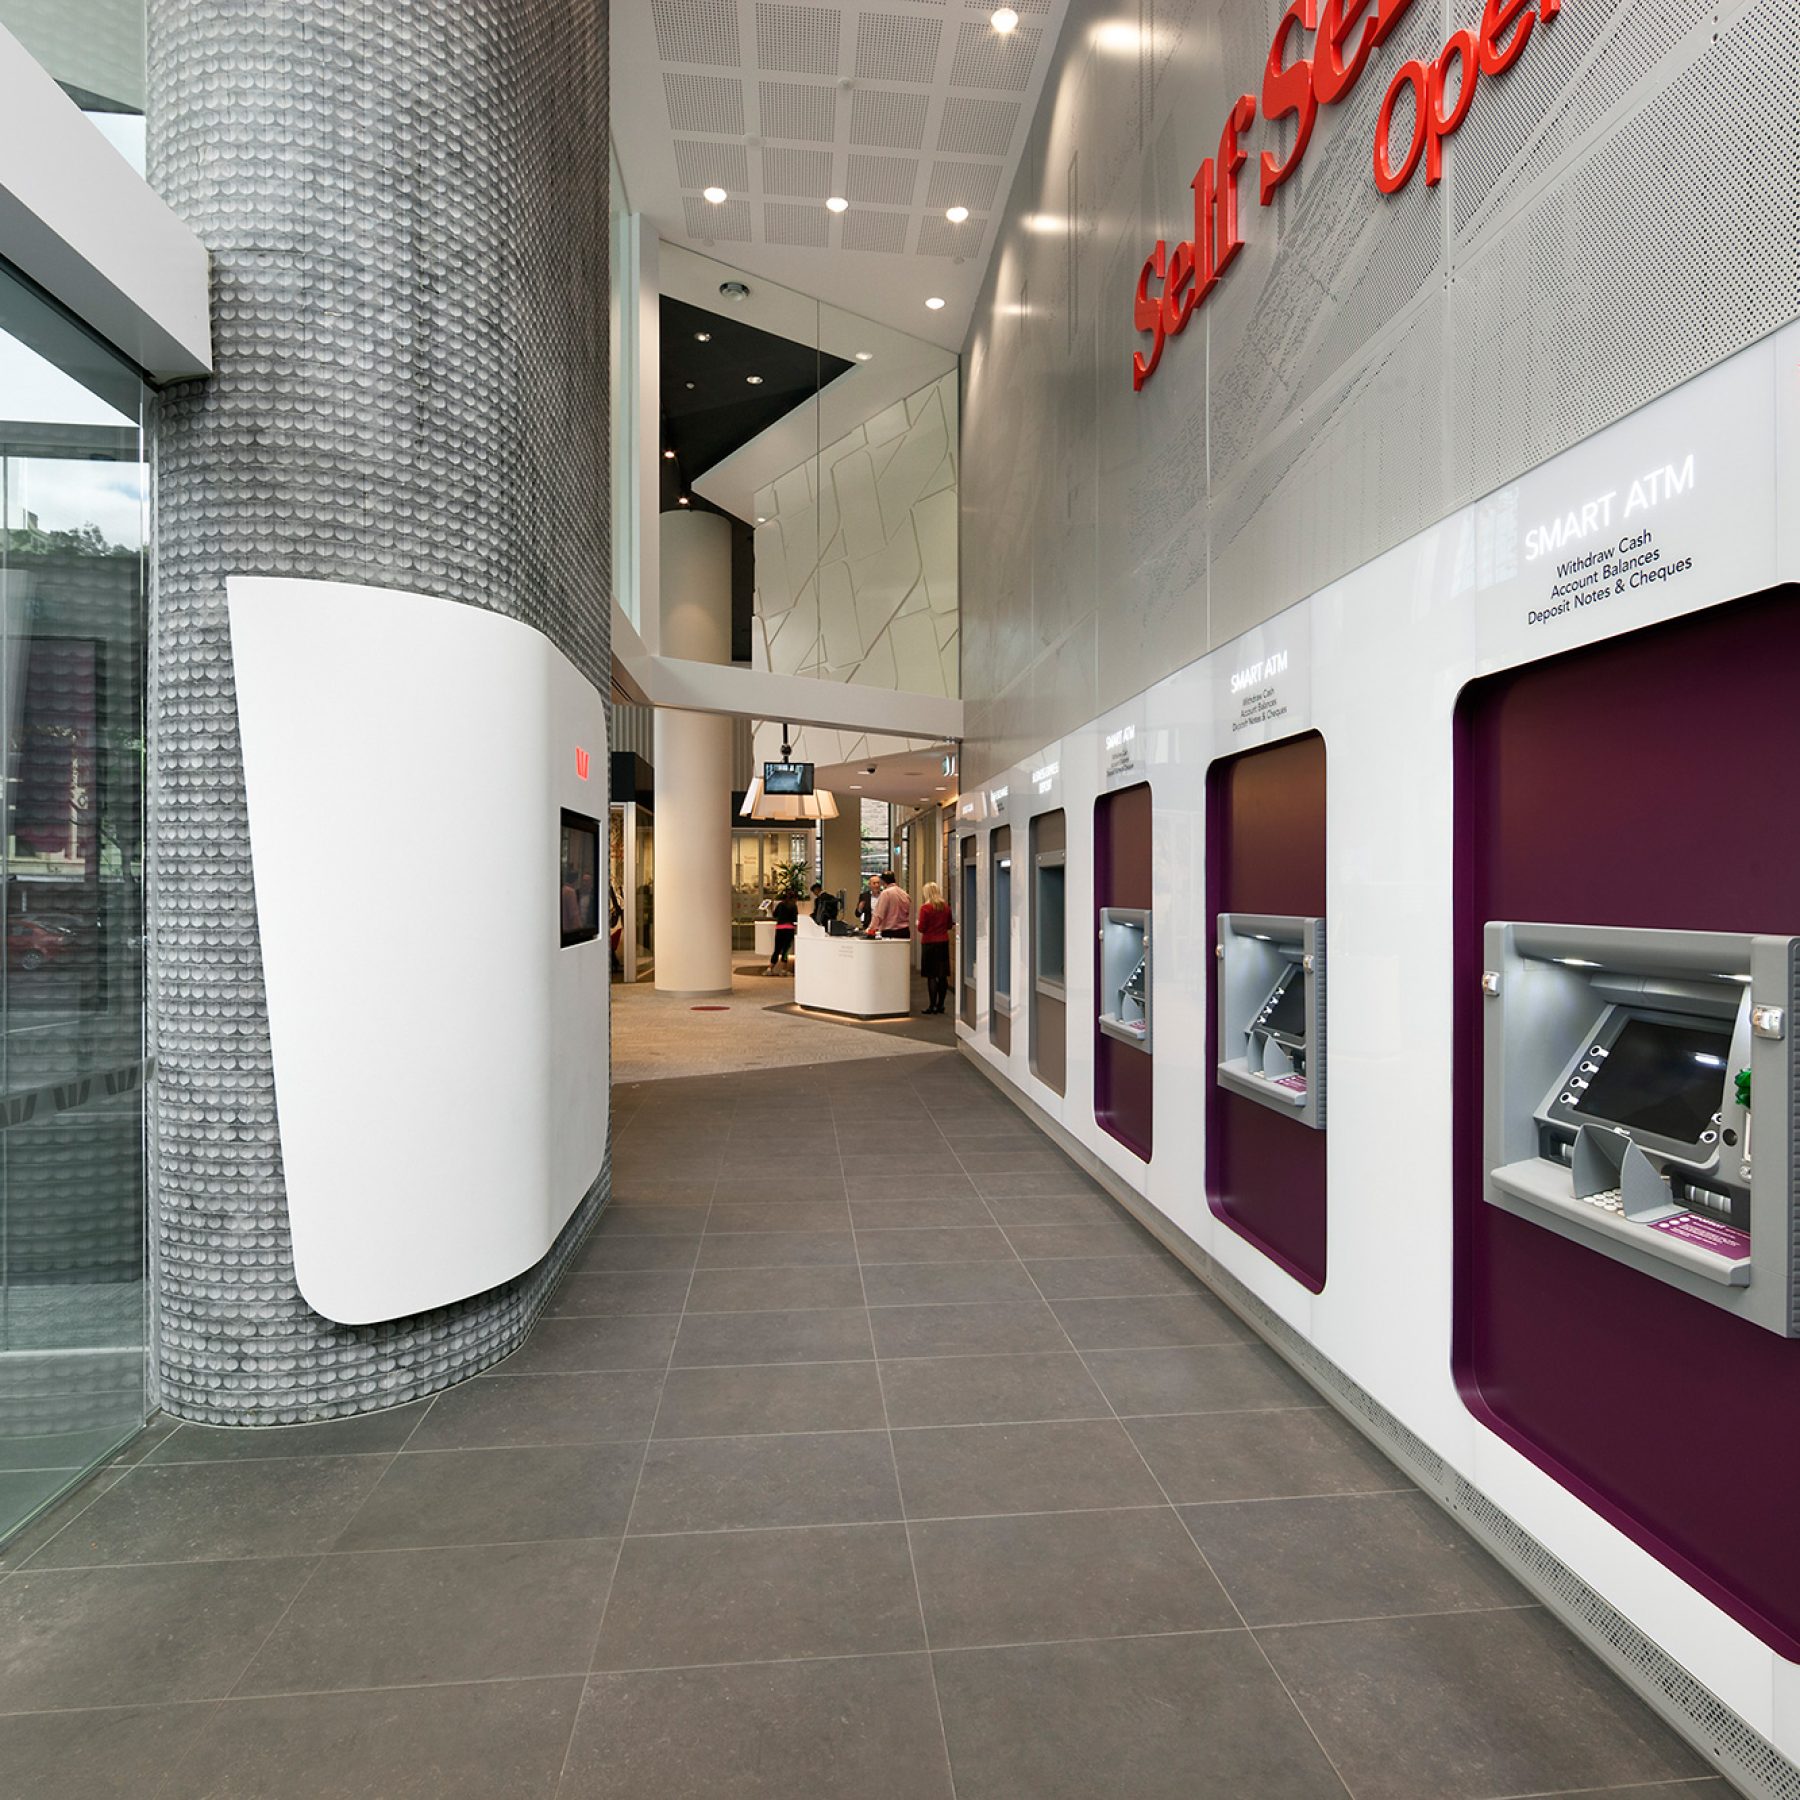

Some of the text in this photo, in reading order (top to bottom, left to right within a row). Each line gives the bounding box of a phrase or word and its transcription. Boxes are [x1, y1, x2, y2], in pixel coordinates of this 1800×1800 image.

[1373, 0, 1561, 194] Ope
[1133, 94, 1257, 392] Self
[1524, 453, 1695, 561] SMART ATM
[1550, 547, 1661, 599] Account Balances
[1556, 528, 1653, 579] Withdraw Cash
[1527, 555, 1693, 625] Deposit Notes & Cheques
[1230, 649, 1288, 694] SMART ATM
